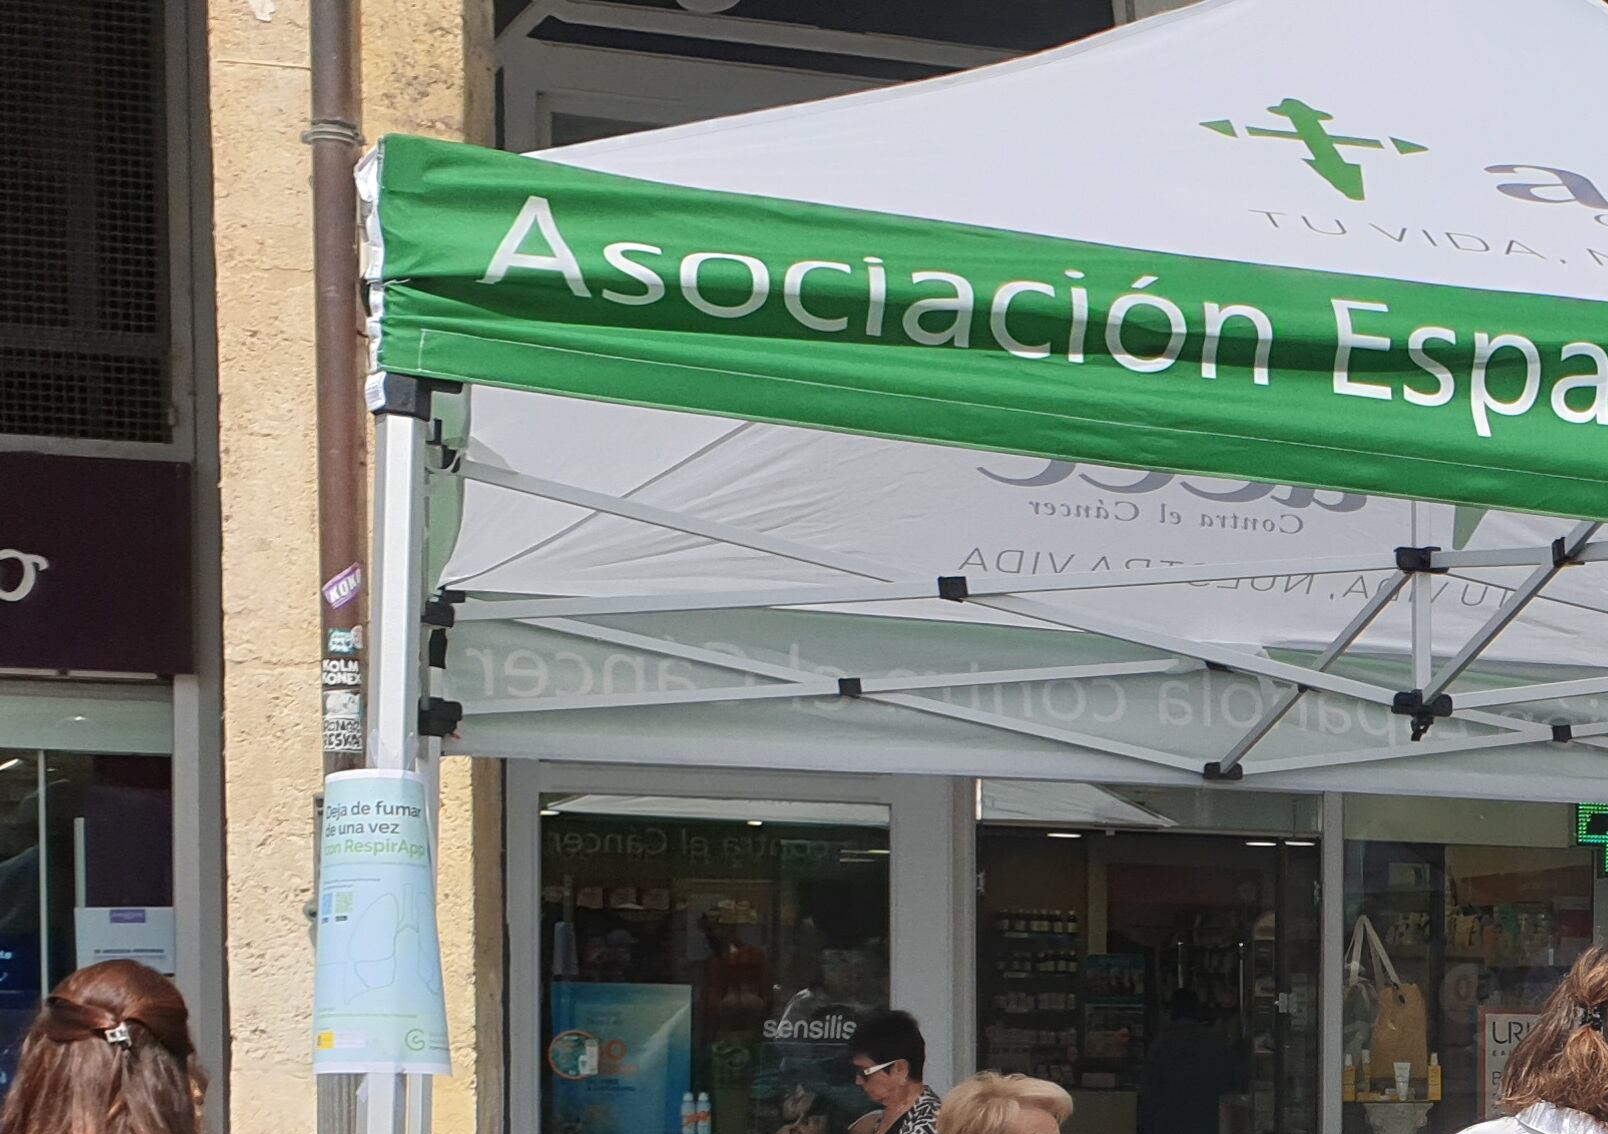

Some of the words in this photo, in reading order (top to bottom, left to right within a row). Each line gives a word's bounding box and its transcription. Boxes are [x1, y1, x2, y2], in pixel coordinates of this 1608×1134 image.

[1247, 209, 1347, 236] TU
[477, 195, 1273, 386] Asociación
[325, 803, 348, 820] Deja
[350, 801, 371, 816] de
[375, 801, 422, 818] fumar
[325, 823, 337, 838] de
[338, 822, 365, 836] una
[367, 822, 400, 835] vez
[344, 838, 425, 860] RespirApp
[762, 1014, 857, 1040] sensilis
